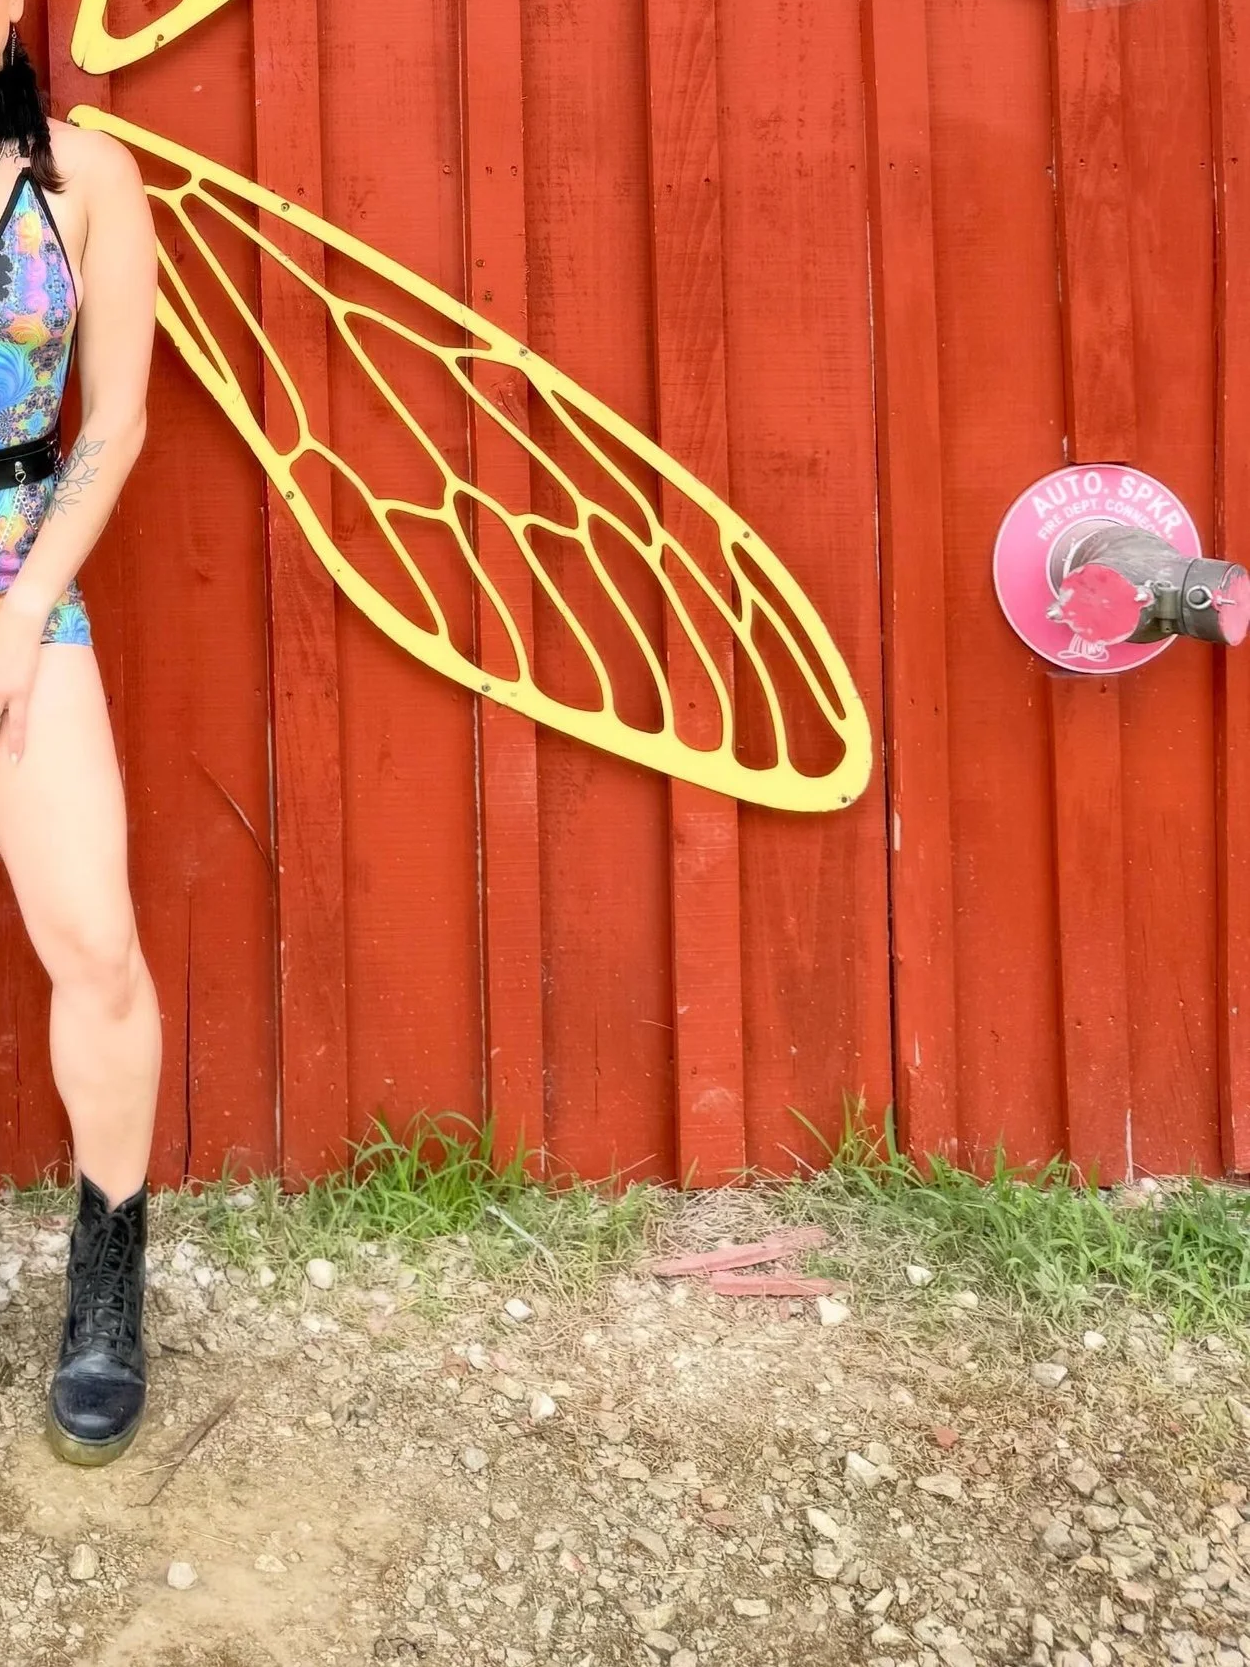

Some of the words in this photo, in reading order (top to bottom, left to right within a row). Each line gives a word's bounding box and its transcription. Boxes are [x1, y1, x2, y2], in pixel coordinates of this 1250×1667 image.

[1032, 471, 1109, 519] AUTO.
[1118, 475, 1183, 539] SPKR.
[1037, 514, 1064, 540] FIRE
